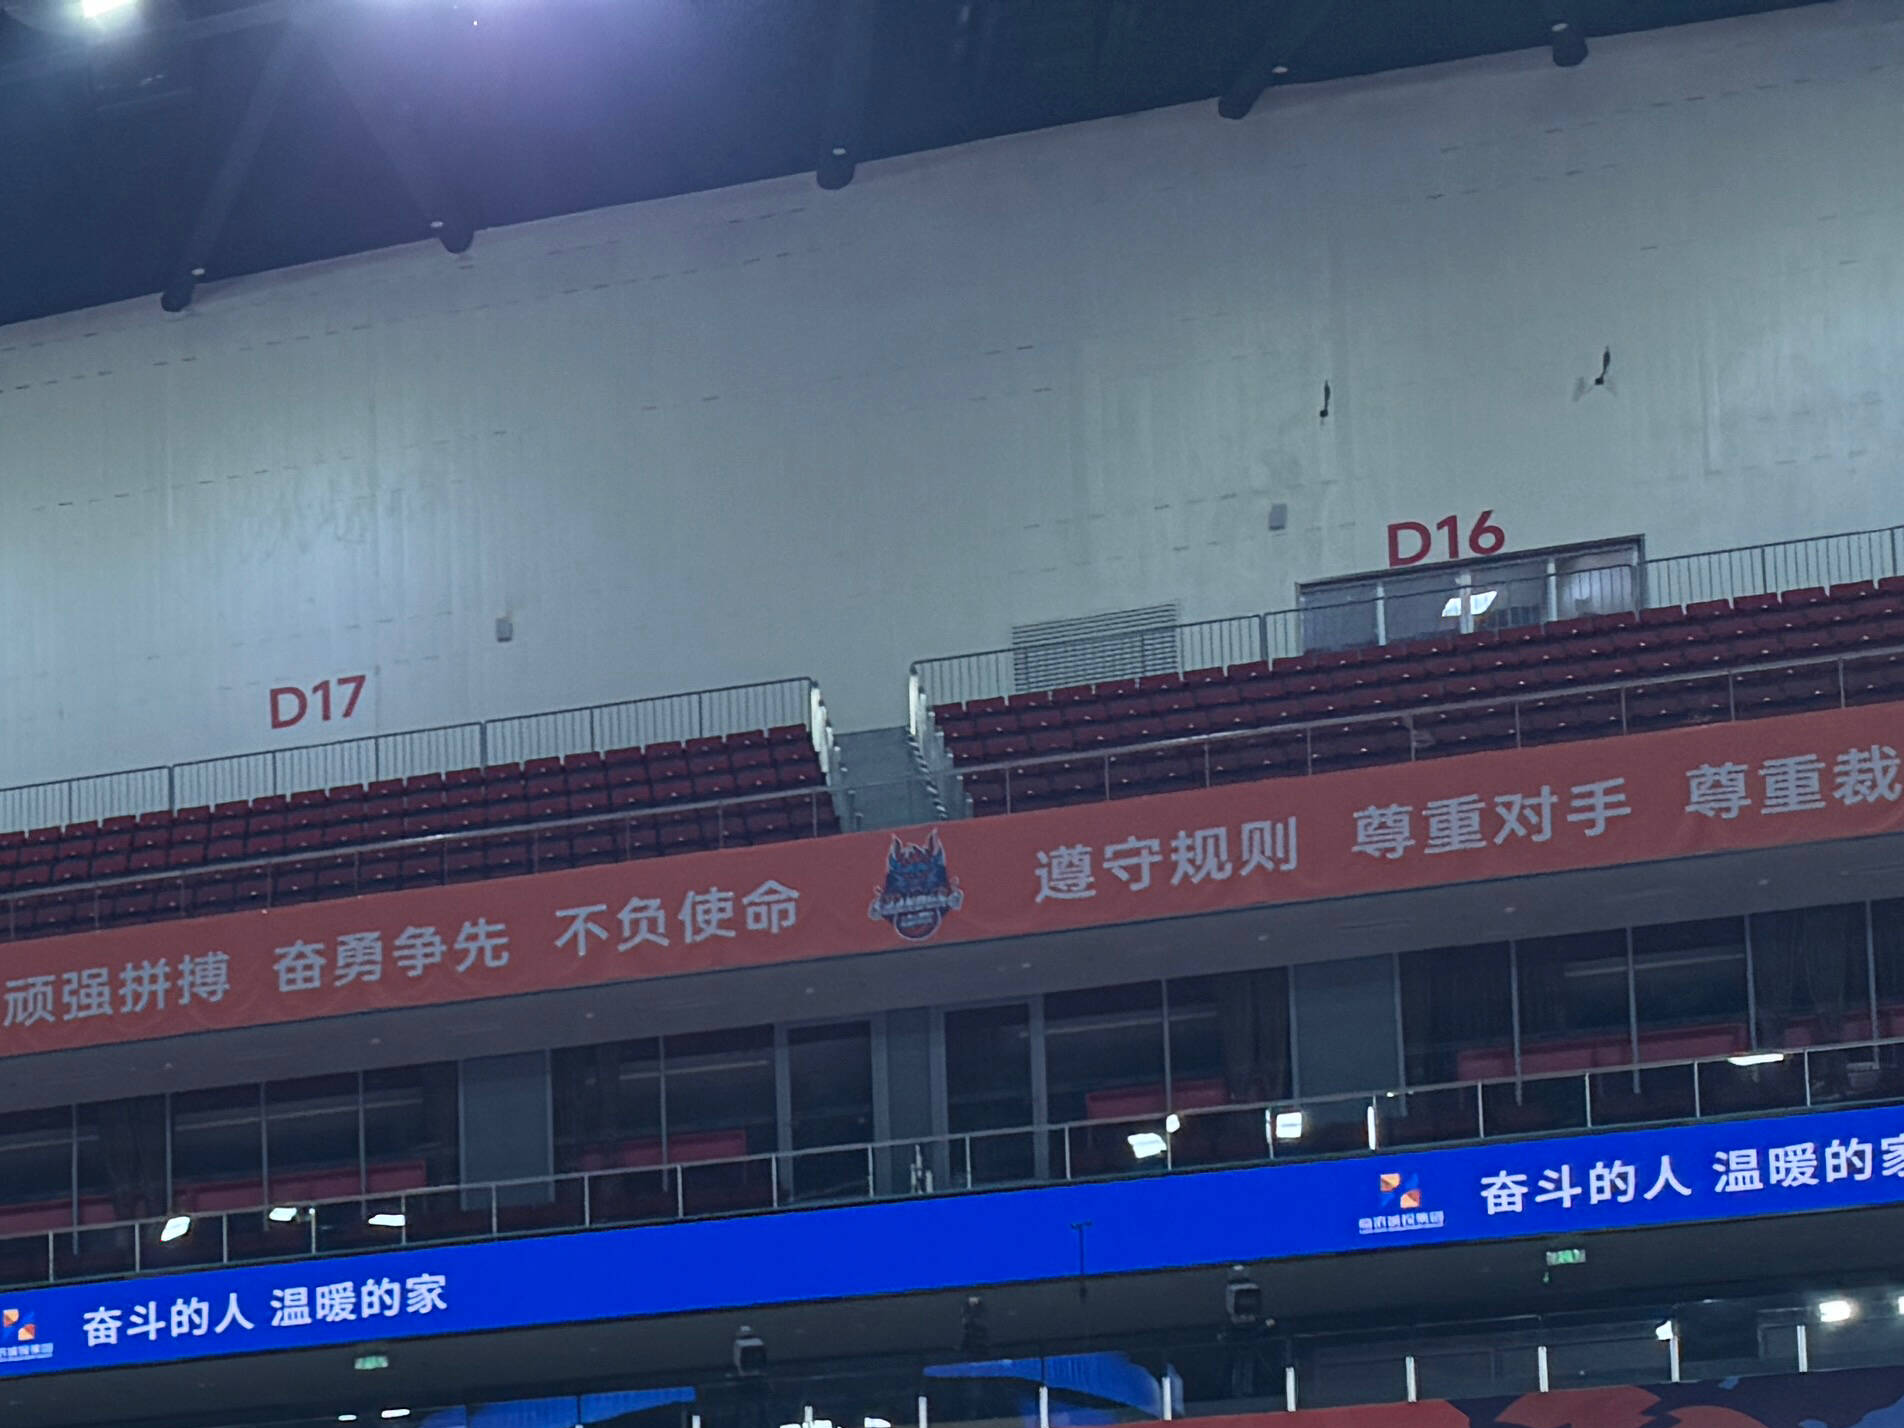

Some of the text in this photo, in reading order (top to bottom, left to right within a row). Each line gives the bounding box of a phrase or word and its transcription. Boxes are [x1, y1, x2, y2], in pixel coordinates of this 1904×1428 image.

[1387, 510, 1506, 568] D16
[269, 675, 366, 730] D17
[1034, 745, 1903, 904] 遵守规则 尊重对手 尊重裁
[3, 951, 230, 1028] 顽强拼搏
[273, 917, 510, 994] 奋勇争先
[554, 880, 800, 958] 不负使命
[1480, 1159, 1693, 1216] 奋斗的人
[82, 1273, 448, 1348] 奋斗的人 温暖的家
